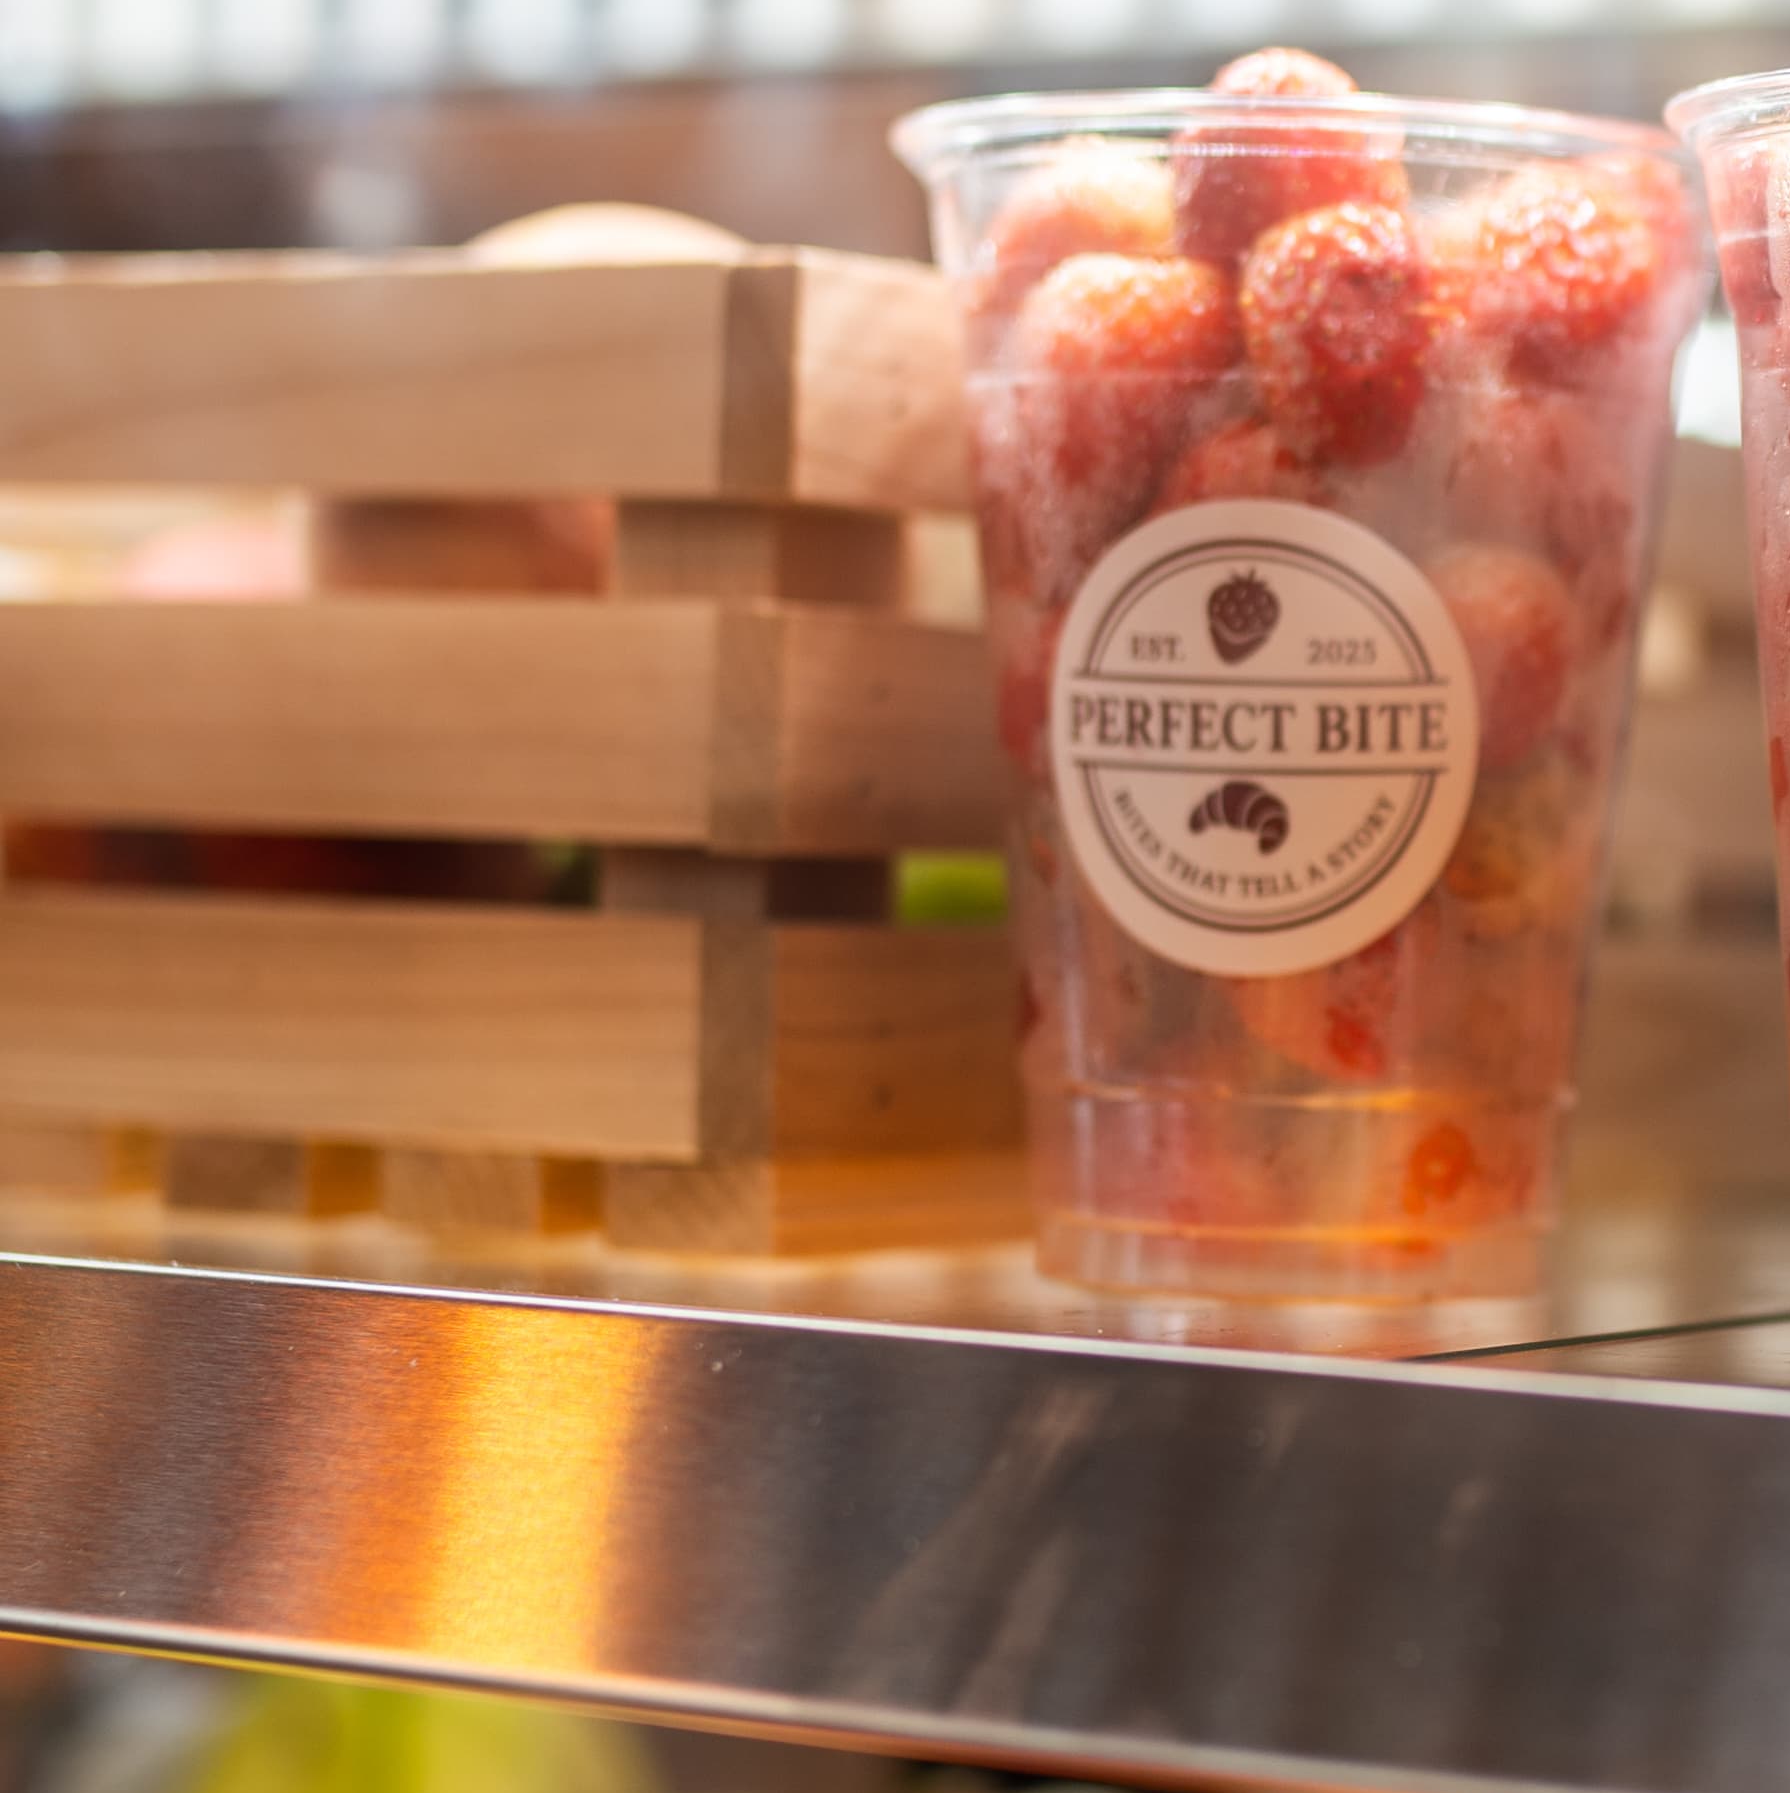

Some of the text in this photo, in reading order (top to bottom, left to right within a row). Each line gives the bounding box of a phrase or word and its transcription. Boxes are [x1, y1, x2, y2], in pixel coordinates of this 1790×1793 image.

[1130, 634, 1377, 667] EST. 2025
[1070, 694, 1449, 754] PERFECT BITE
[1167, 851, 1229, 895] THAT
[1237, 874, 1298, 898] TELL
[1306, 863, 1325, 882] A
[1326, 794, 1396, 869] STORY
